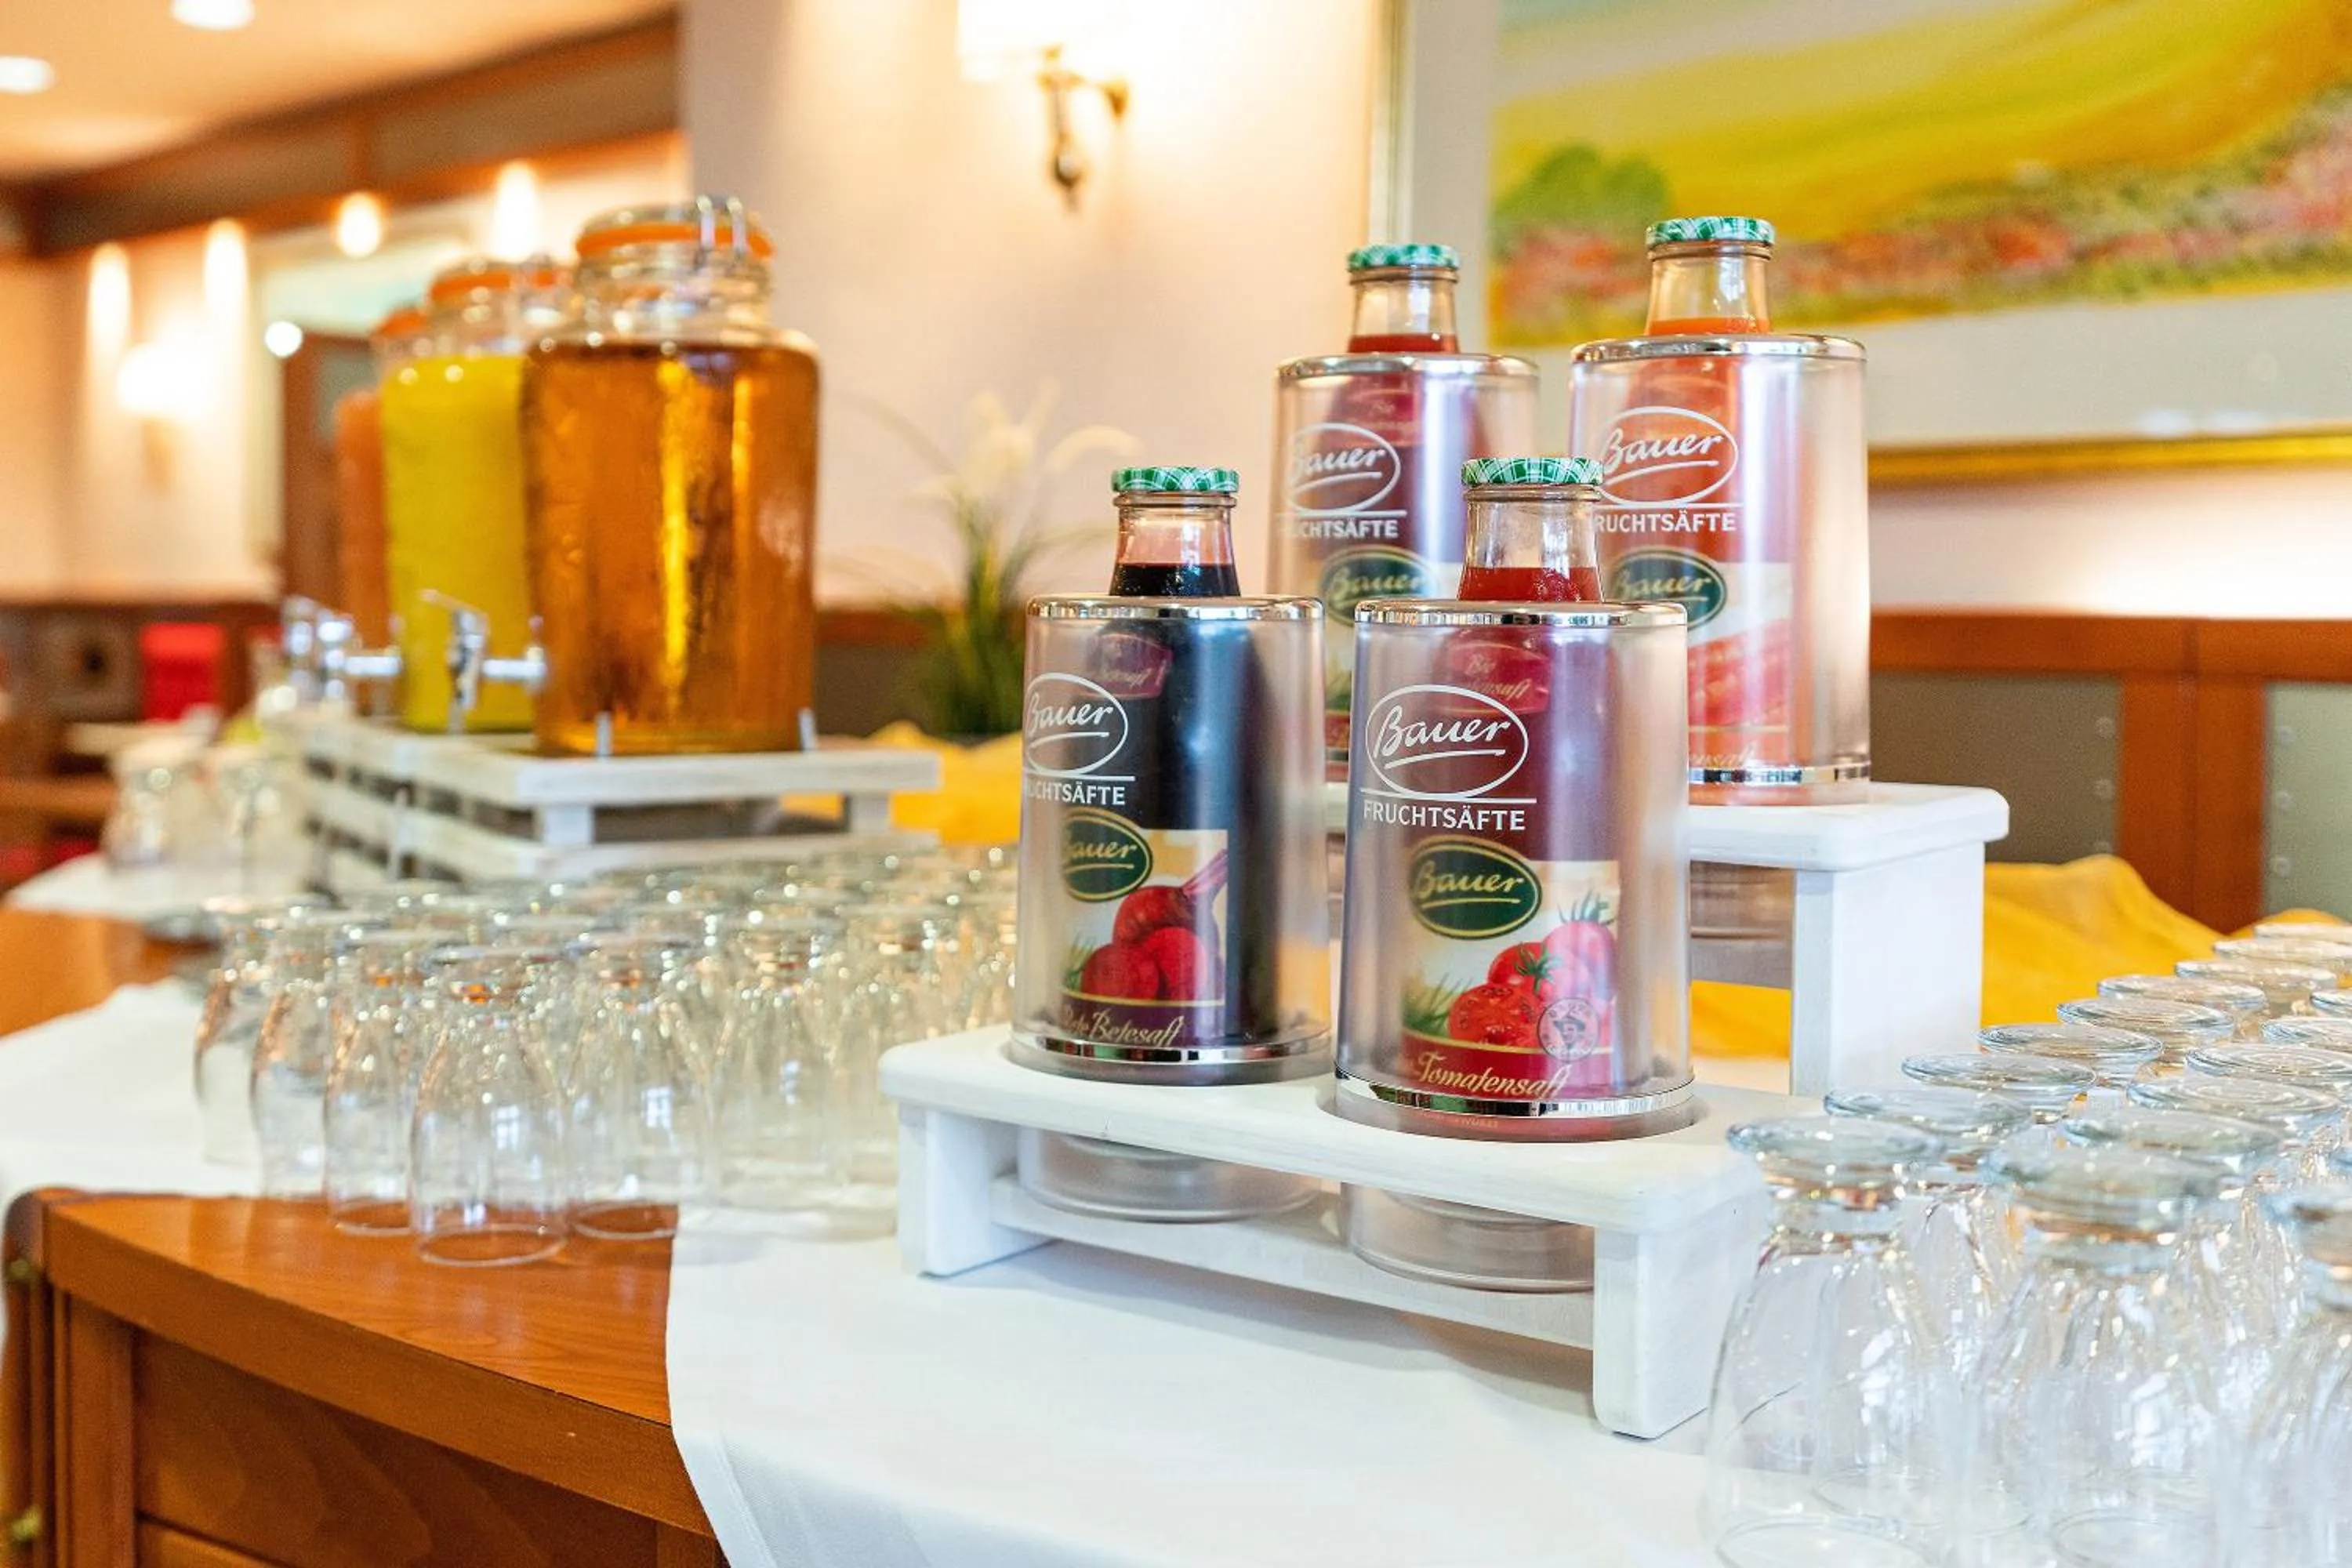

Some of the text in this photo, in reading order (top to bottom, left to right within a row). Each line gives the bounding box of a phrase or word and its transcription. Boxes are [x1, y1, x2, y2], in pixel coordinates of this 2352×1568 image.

[1601, 428, 1724, 475] Bauer
[1592, 510, 1737, 534] RUCHTSÄFTE
[1373, 705, 1512, 760] Bauer
[1363, 800, 1526, 831] FRUCHTSÄFTE
[1414, 860, 1524, 899] Bauer
[1417, 1051, 1573, 1100] Tomatensaft
